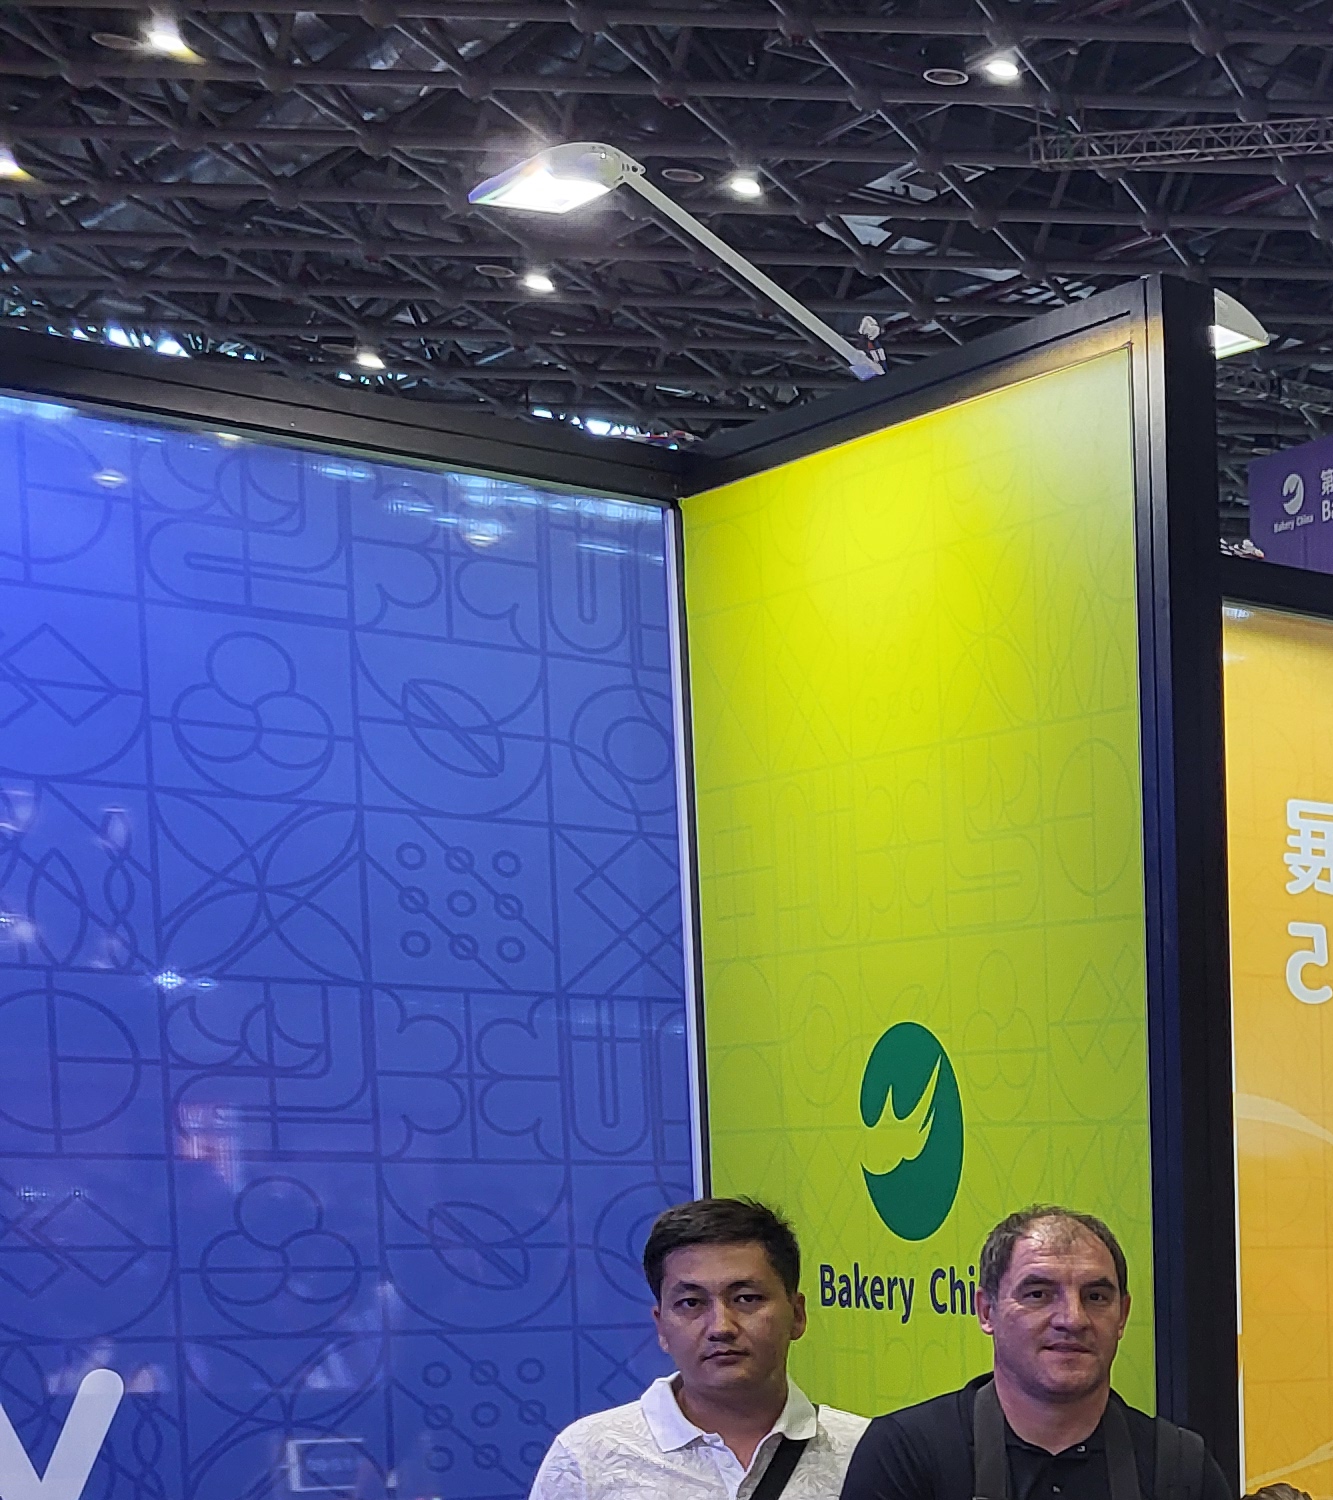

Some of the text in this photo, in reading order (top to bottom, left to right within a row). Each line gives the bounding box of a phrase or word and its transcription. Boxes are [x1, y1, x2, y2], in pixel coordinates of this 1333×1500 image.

[1273, 513, 1314, 534] Bakery China
[819, 1262, 976, 1324] Bakery Chi
